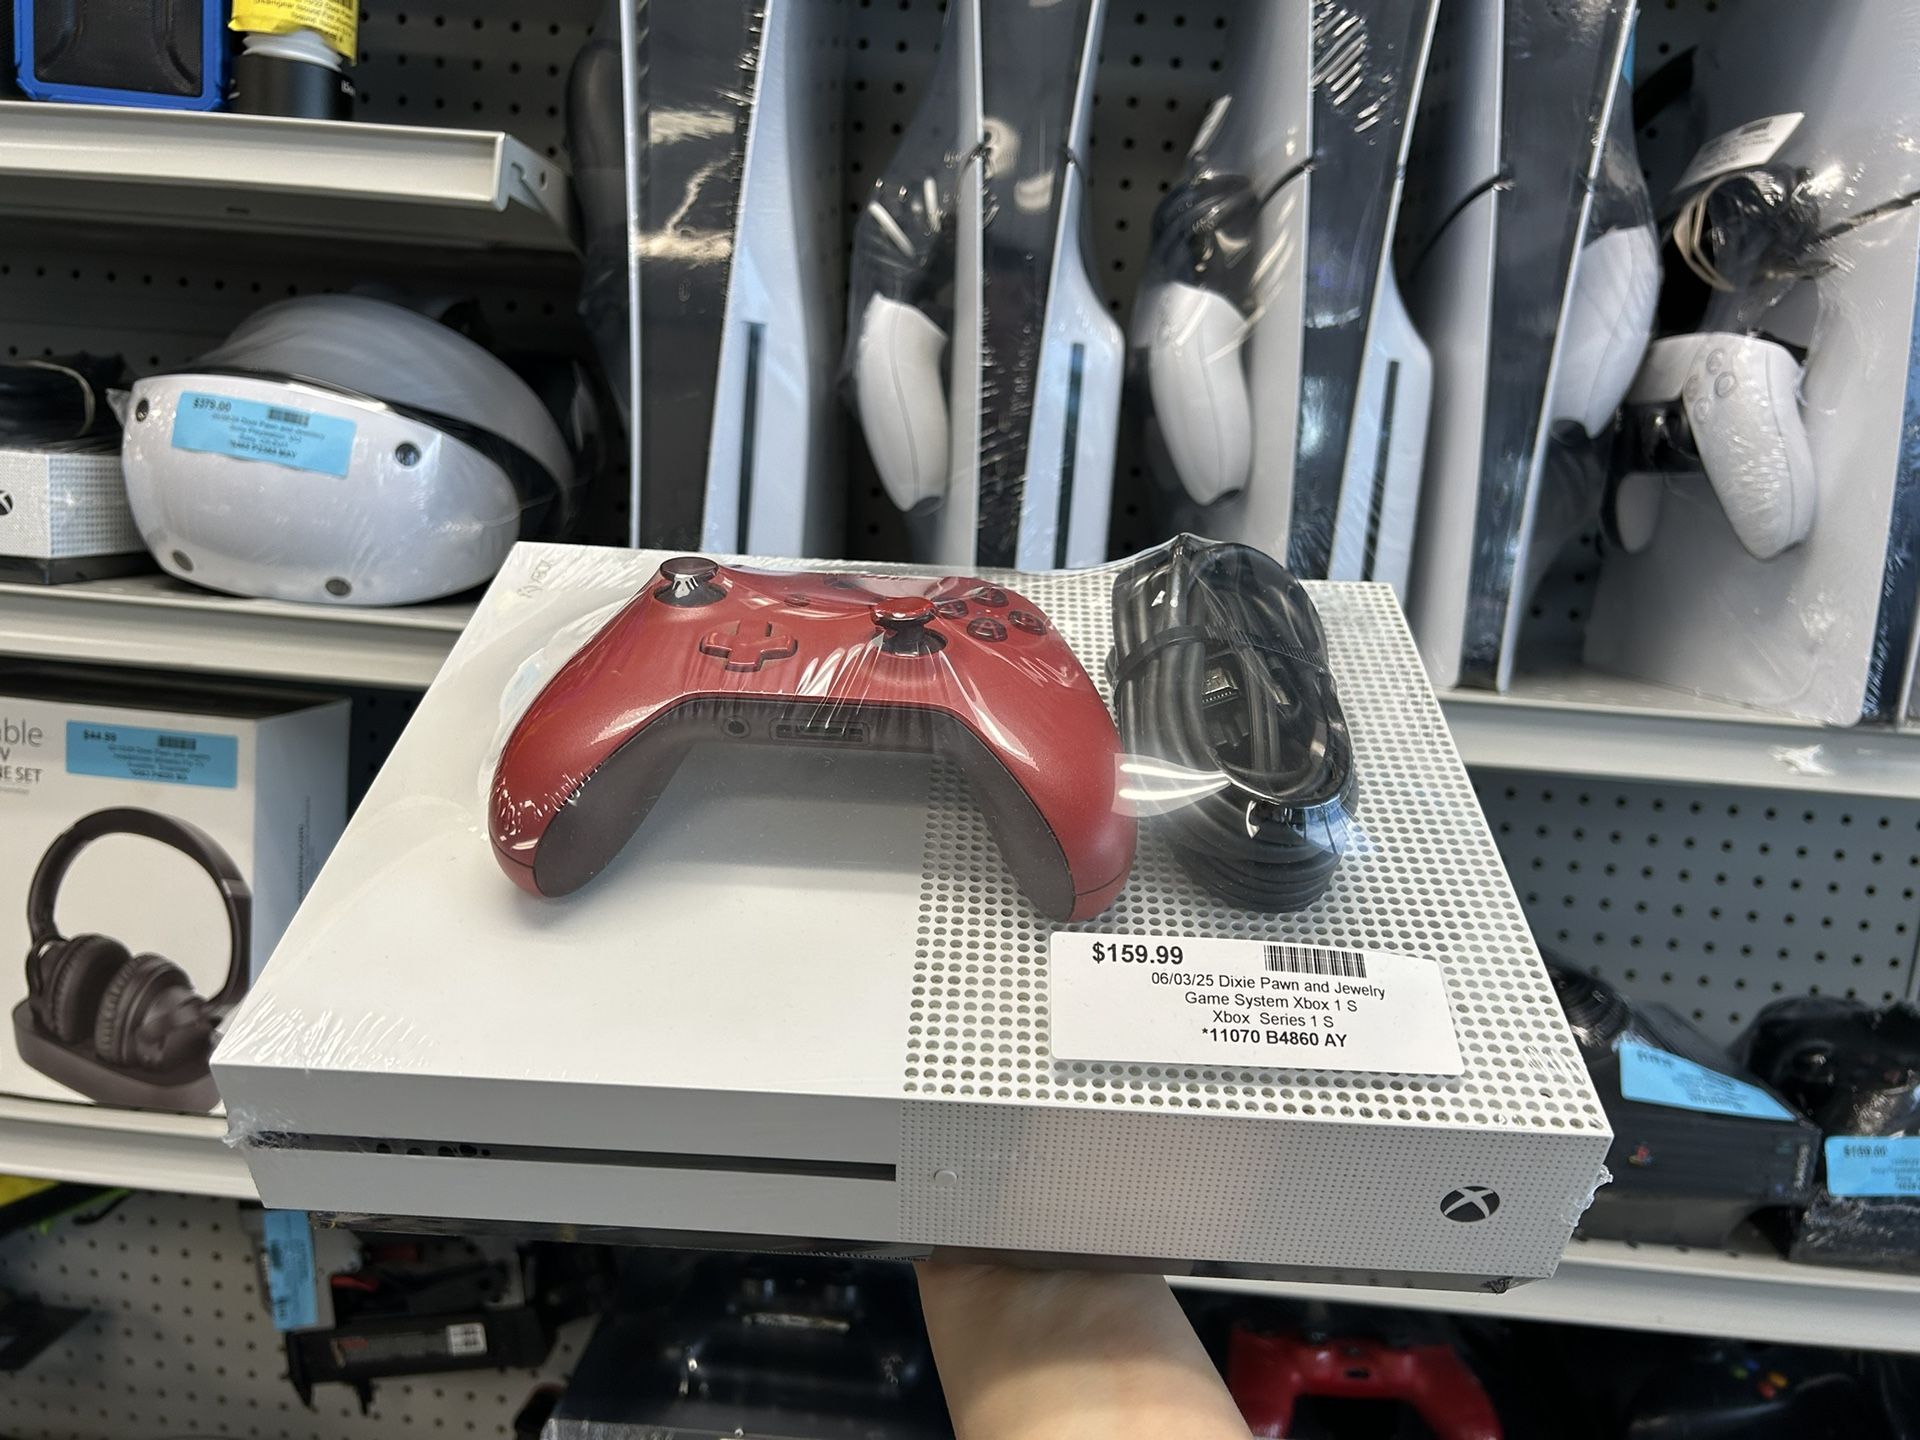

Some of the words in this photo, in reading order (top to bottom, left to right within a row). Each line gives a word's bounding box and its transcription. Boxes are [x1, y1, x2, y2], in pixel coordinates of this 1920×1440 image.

[0, 717, 43, 747] ble
[16, 767, 43, 783] SET
[1092, 941, 1184, 965] $159.99
[1151, 972, 1214, 987] 06/03/25
[1219, 975, 1255, 988] Dixie
[1260, 977, 1299, 991] Pawn
[1304, 981, 1330, 993] and
[1334, 982, 1385, 1001] Jewelry
[1185, 991, 1230, 1005] Game
[1234, 993, 1289, 1009] System
[1293, 996, 1330, 1011] Xbox
[1334, 999, 1341, 1011] 1
[1347, 1000, 1358, 1012] S
[1213, 1010, 1250, 1024] Xbox
[1259, 1012, 1306, 1027] Series
[1310, 1015, 1317, 1027] 1
[1323, 1016, 1334, 1028] S
[1266, 1030, 1319, 1046] B4860
[1324, 1033, 1347, 1047] AY
